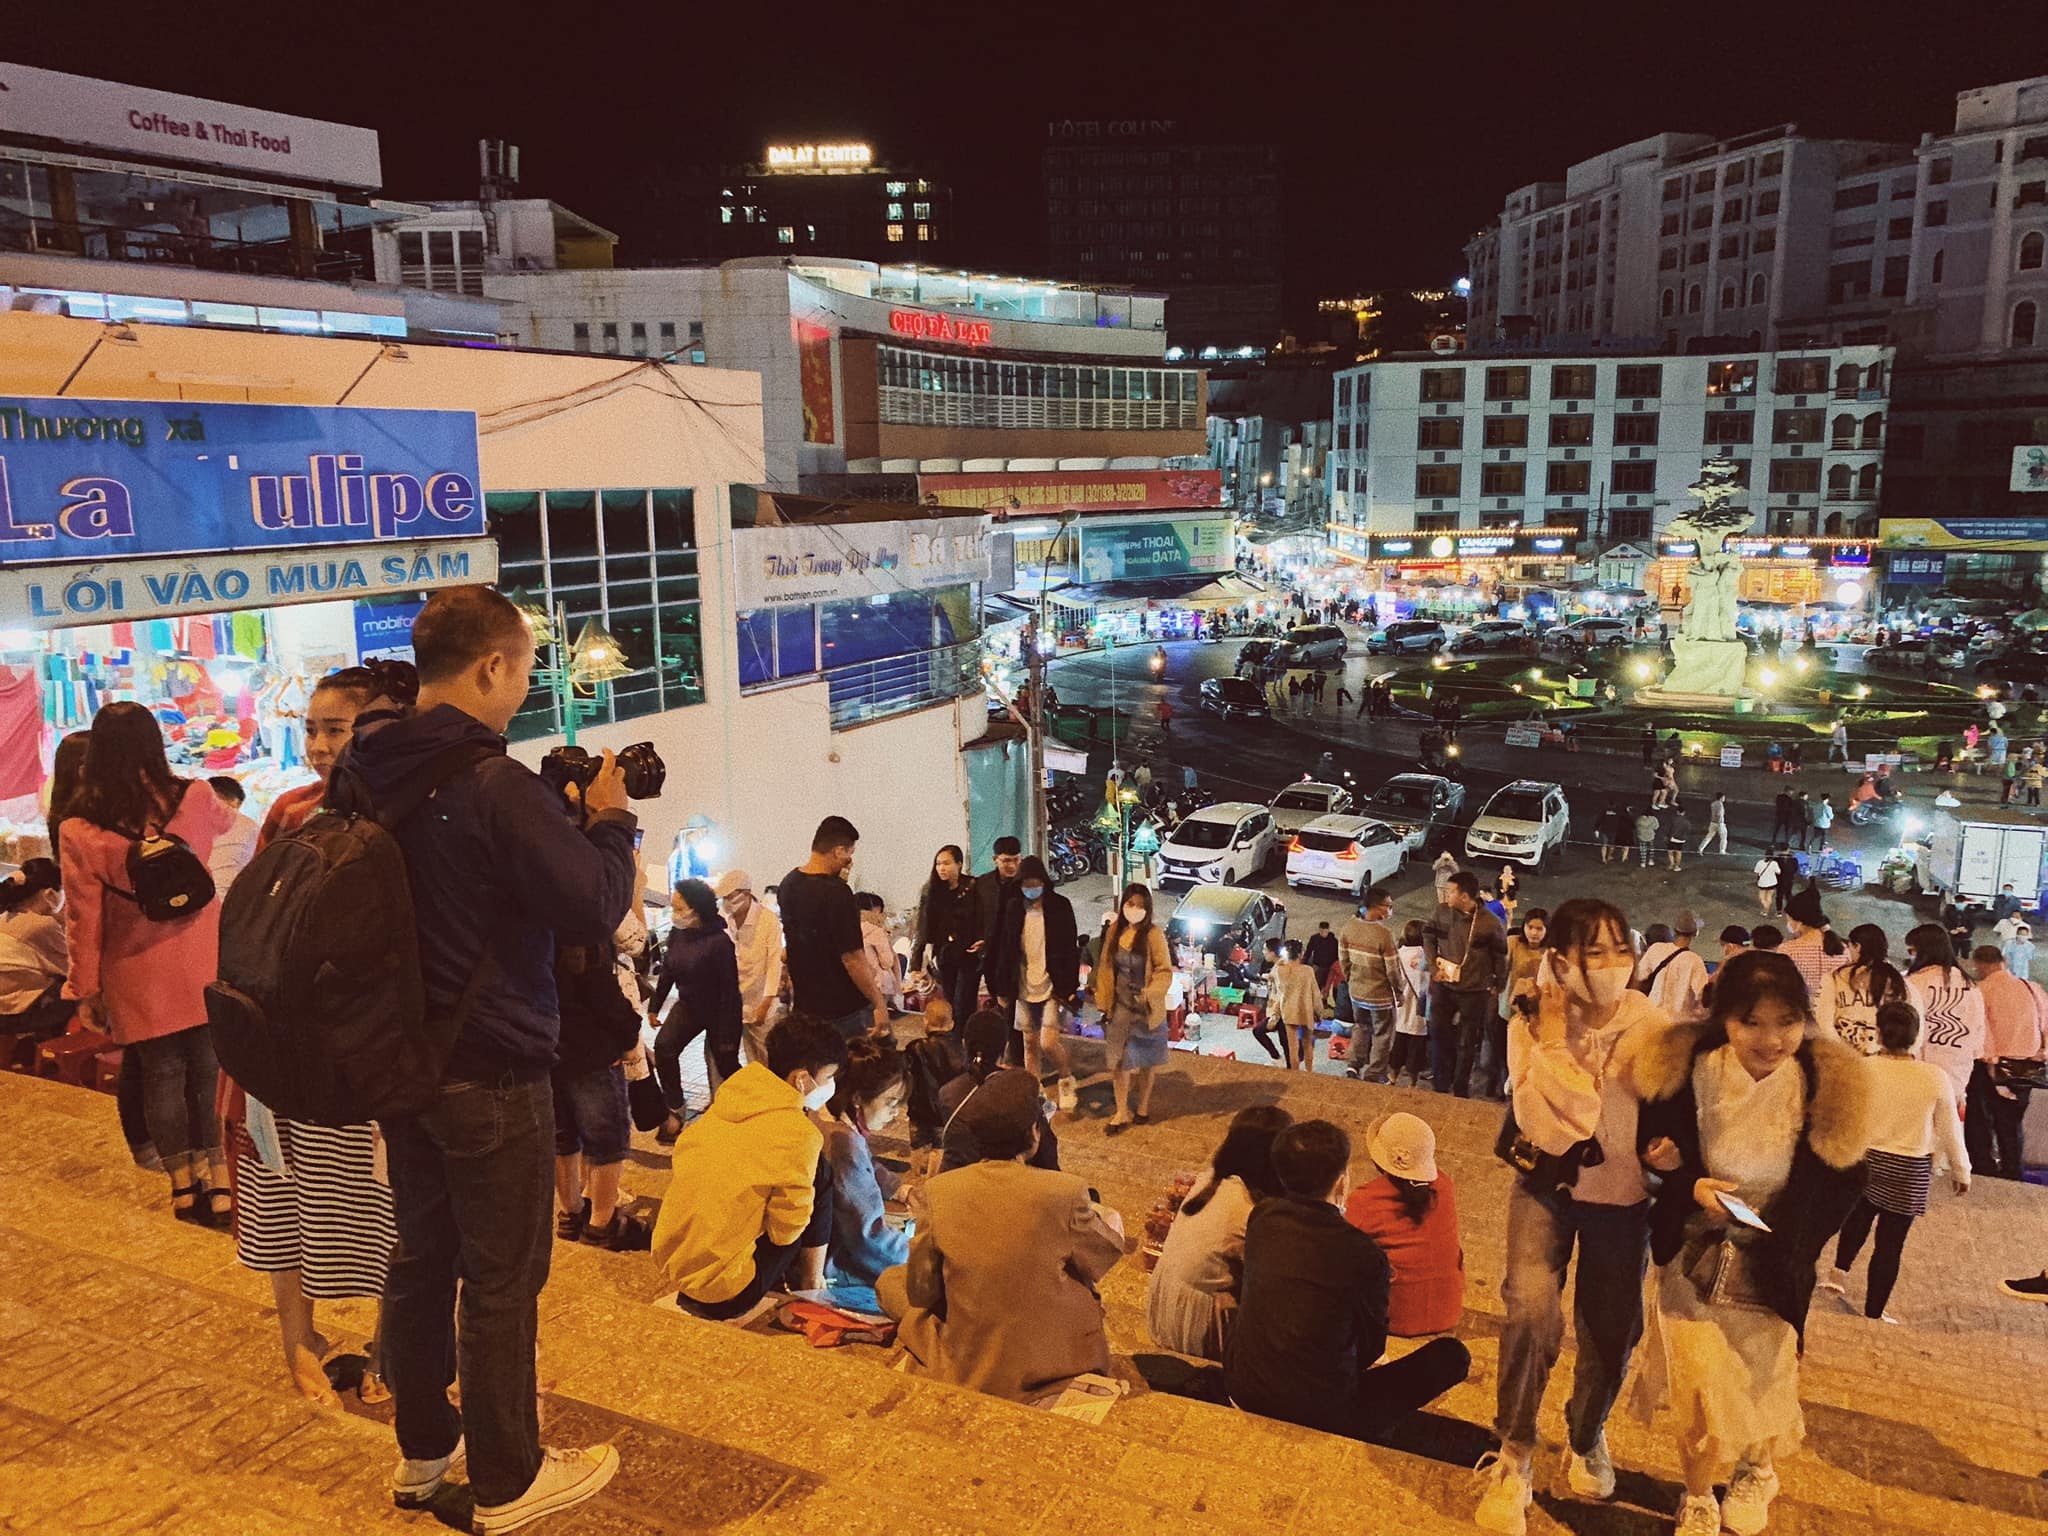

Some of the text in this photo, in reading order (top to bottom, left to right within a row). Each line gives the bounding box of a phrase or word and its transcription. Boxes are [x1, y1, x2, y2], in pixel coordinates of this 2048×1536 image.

[128, 110, 292, 155] Coffee & Thai Food
[768, 143, 871, 163] DALAT CENTER
[890, 311, 922, 339] CHỢ
[955, 320, 991, 346] LẠT
[0, 455, 135, 541] La
[801, 552, 842, 578] Trang
[1152, 549, 1182, 564] DATA
[1930, 560, 1944, 573] XE
[143, 564, 250, 606] VÀO
[268, 560, 369, 596] MUA
